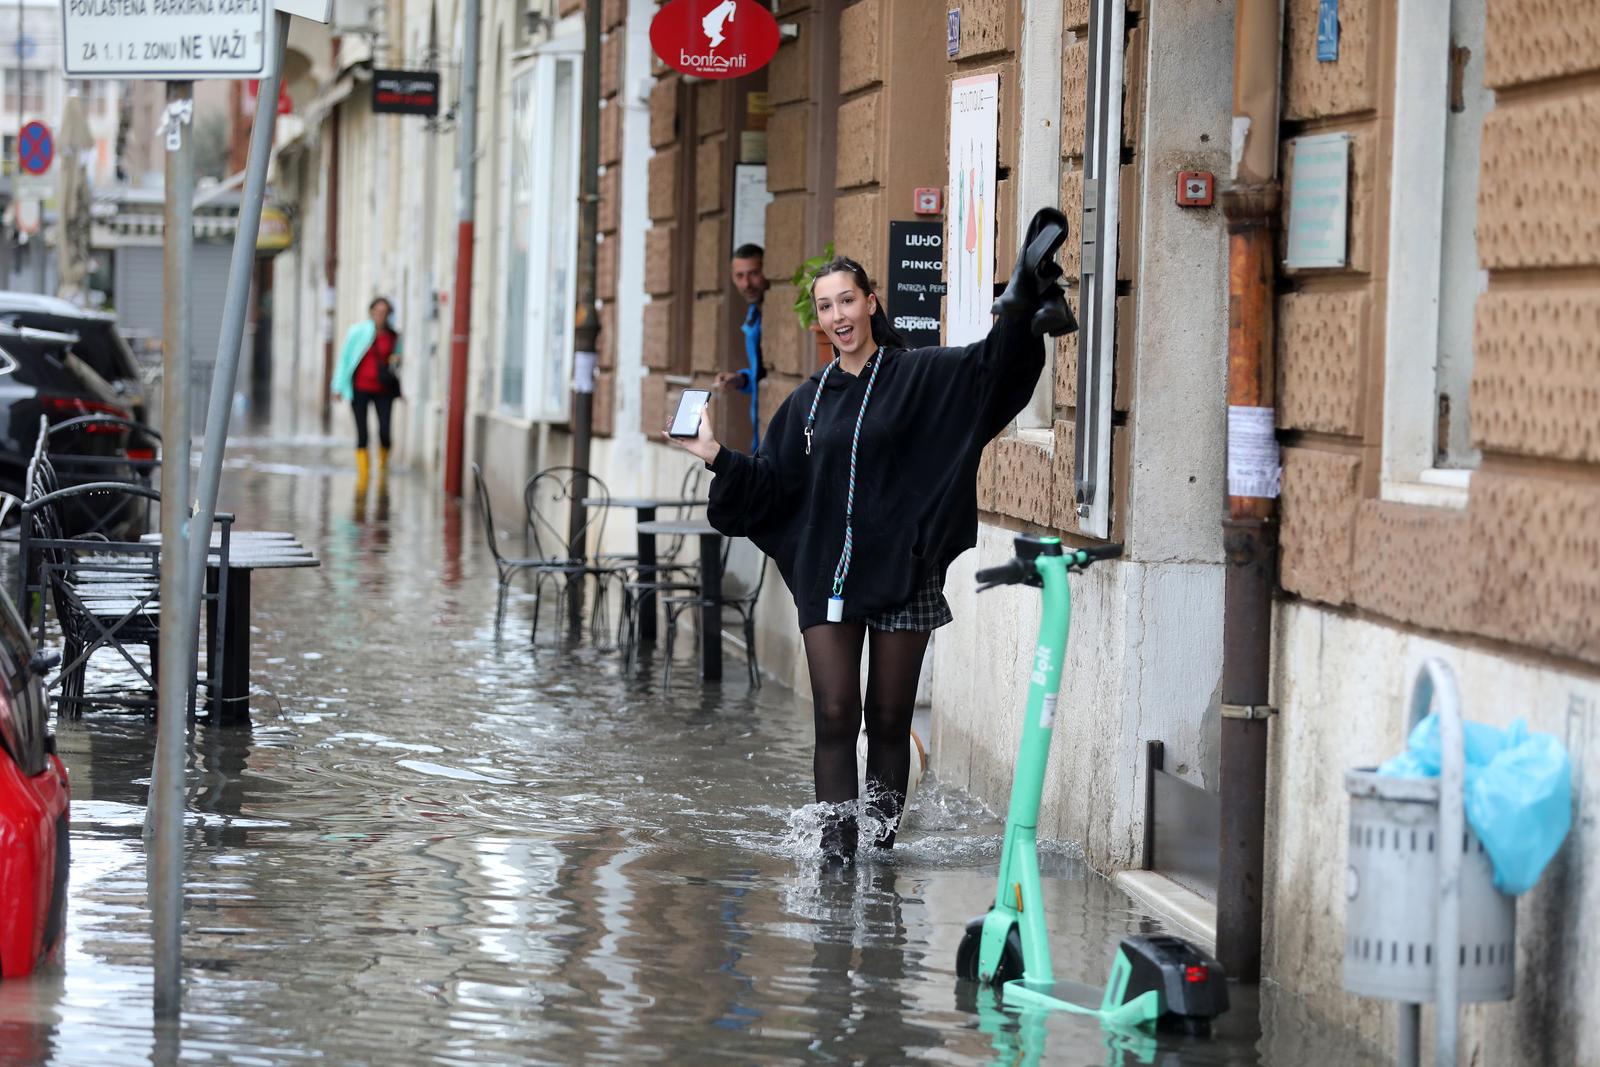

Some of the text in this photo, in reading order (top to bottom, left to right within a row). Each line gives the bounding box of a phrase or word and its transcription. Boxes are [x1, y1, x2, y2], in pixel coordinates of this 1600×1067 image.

[153, 0, 214, 16] PARKIRNA
[218, 0, 260, 15] KARTA
[82, 43, 97, 60] ZA
[143, 42, 177, 60] ZONU
[181, 35, 202, 59] NE
[209, 28, 247, 59] VAŽI
[901, 260, 943, 270] PINKO
[1031, 645, 1052, 687] Bolt
